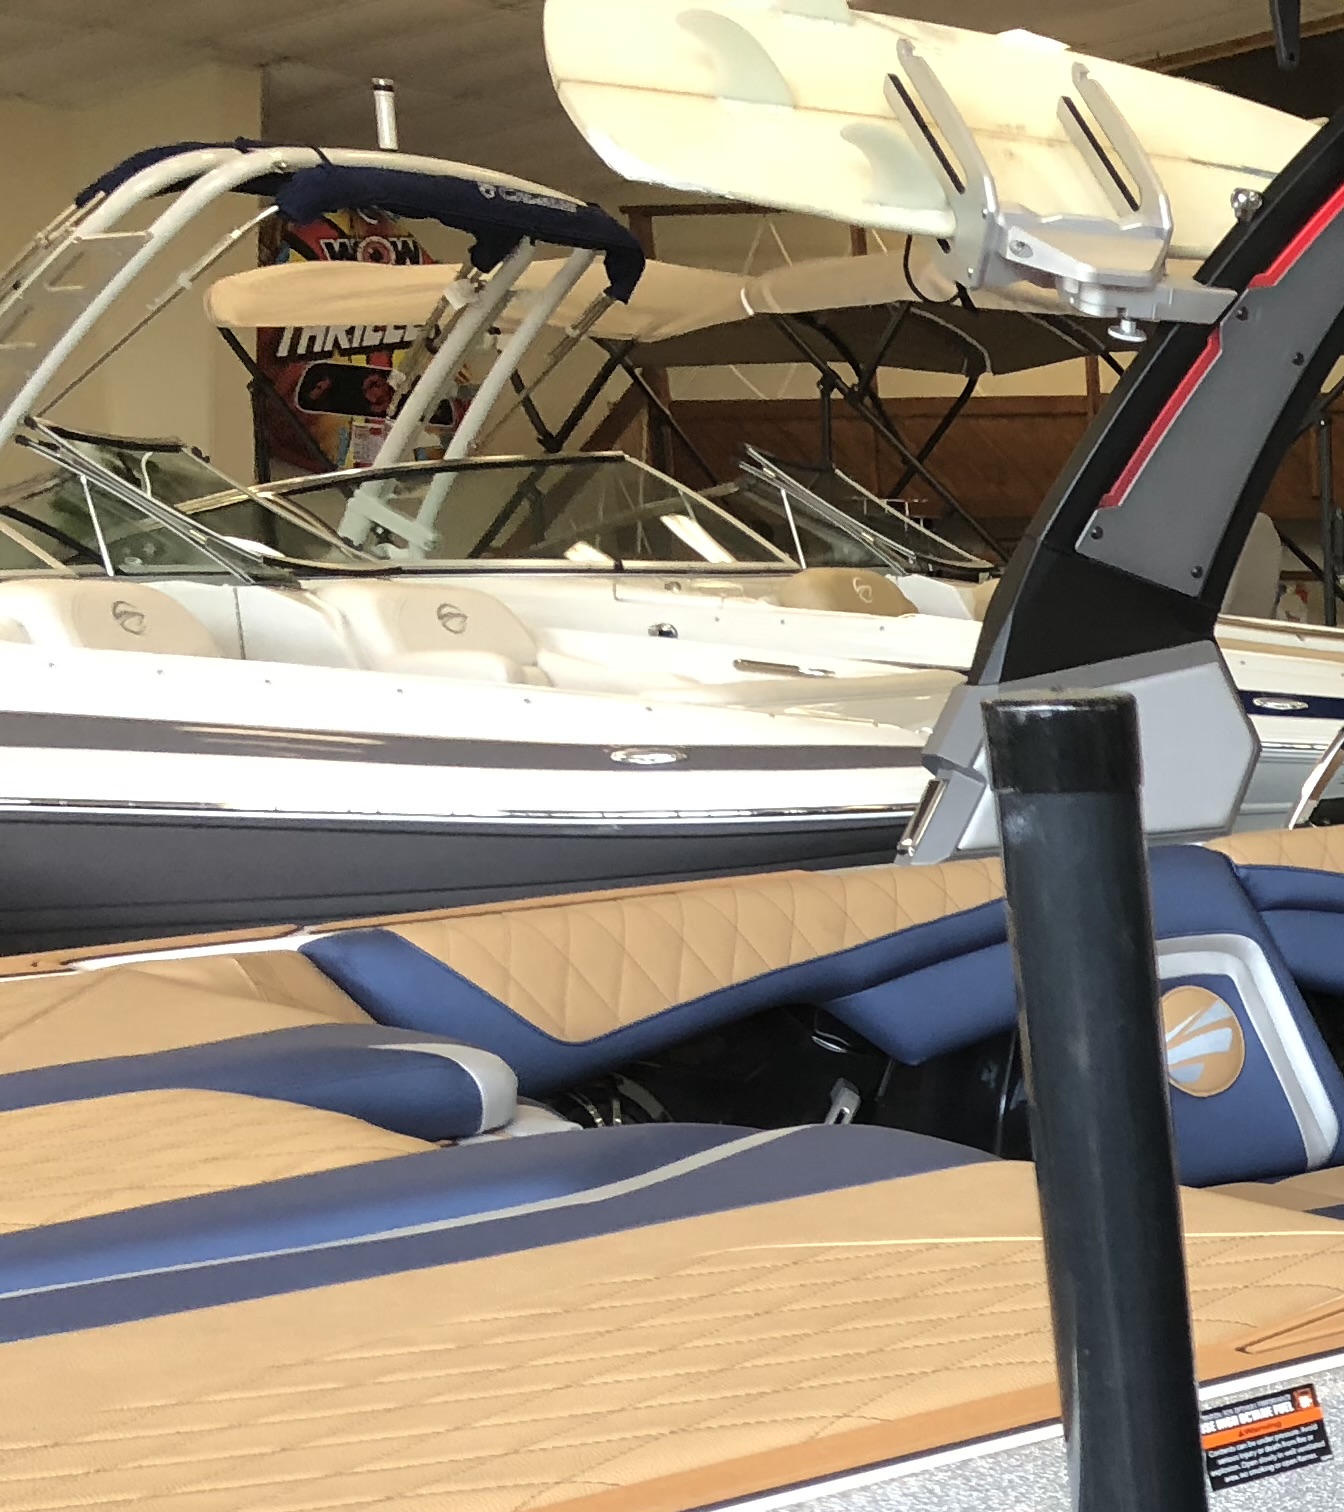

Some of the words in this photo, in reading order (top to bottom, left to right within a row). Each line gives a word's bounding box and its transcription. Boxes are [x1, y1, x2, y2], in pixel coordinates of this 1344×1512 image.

[320, 236, 423, 266] WOW
[277, 325, 440, 357] THRILLE
[1238, 1405, 1273, 1424] OCTANE
[1273, 1400, 1294, 1415] FUEL
[1245, 1420, 1281, 1435] Warning
